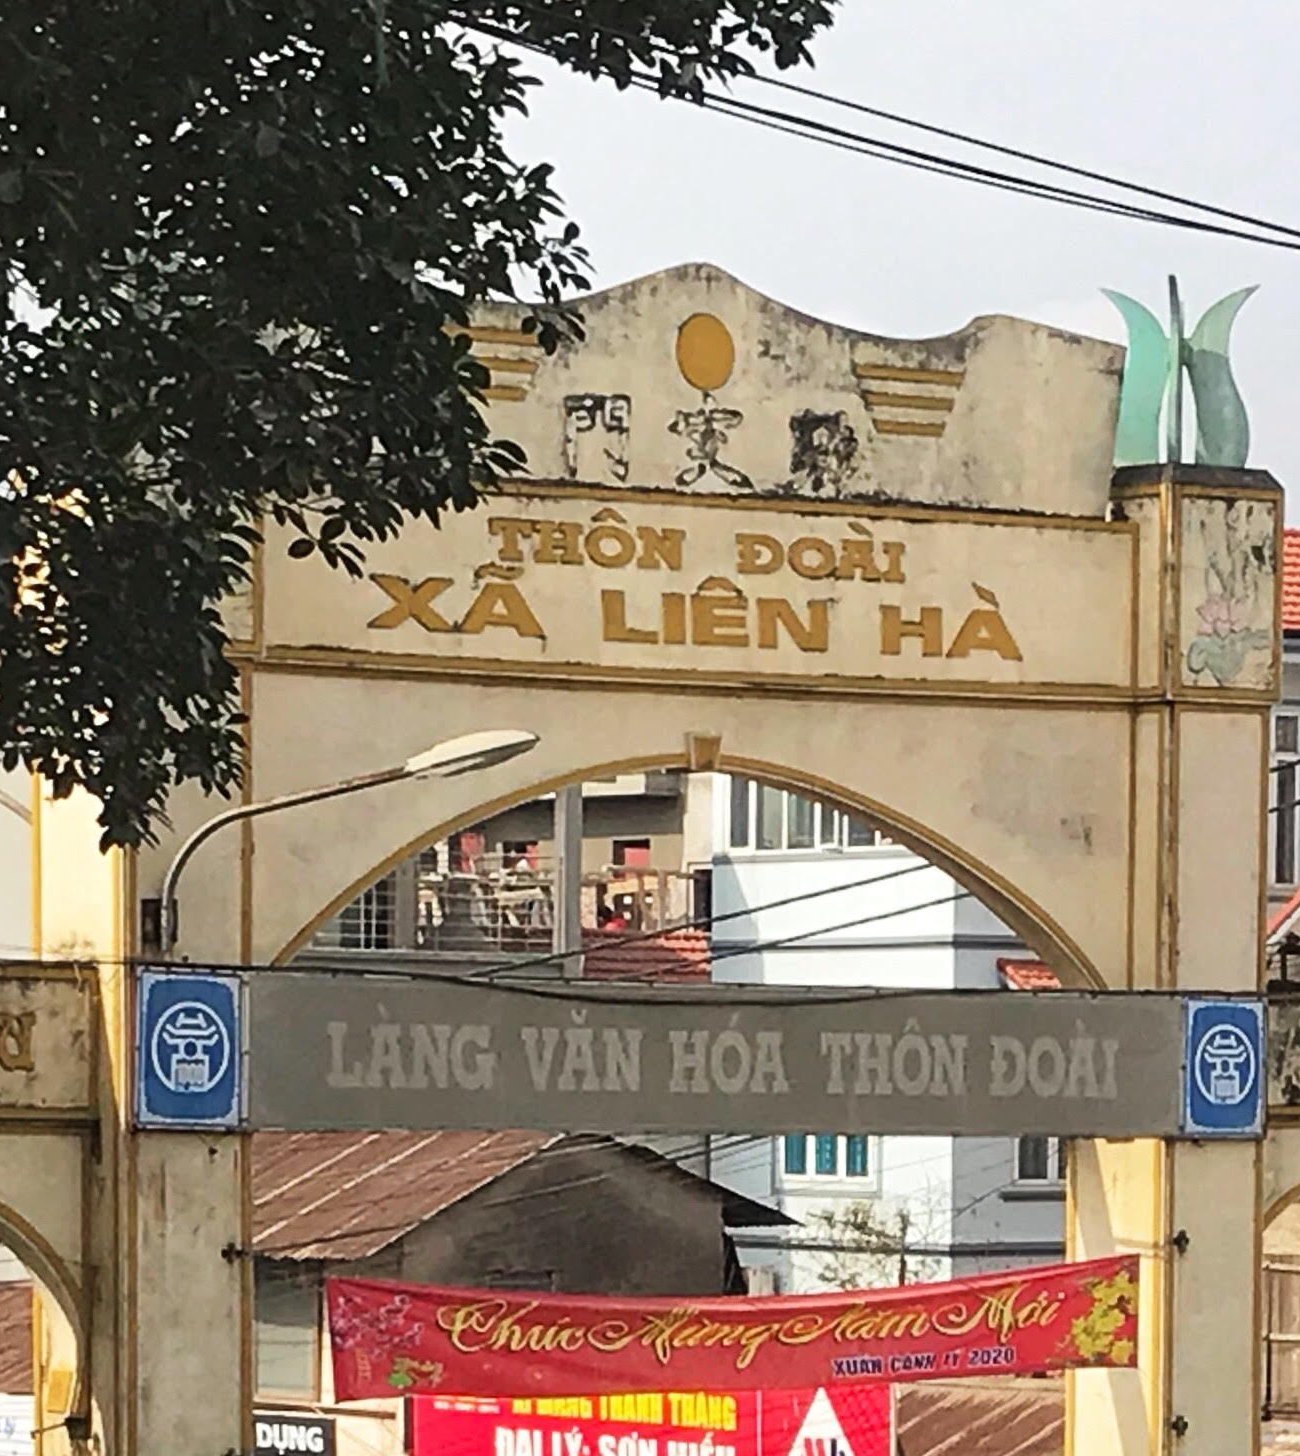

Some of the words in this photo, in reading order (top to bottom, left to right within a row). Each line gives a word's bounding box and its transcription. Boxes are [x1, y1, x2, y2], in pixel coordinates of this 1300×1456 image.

[487, 507, 687, 571] THÔN
[734, 521, 907, 584] ĐOÀI
[366, 561, 547, 641] XÃ
[601, 576, 831, 653] LIÊN
[879, 581, 1024, 661] HÀ
[325, 1005, 500, 1090] LÀNG
[521, 1009, 645, 1094] VĂN
[667, 1011, 791, 1096] HÓA
[819, 1016, 970, 1098] THÔN
[987, 1018, 1120, 1101] ĐOÀI
[437, 1300, 589, 1355] Chúc
[582, 1300, 779, 1369] Mừng
[779, 1299, 929, 1345] Năm
[928, 1282, 1066, 1345] Mới
[968, 1345, 1016, 1368] 2020
[255, 1421, 325, 1456] DỤNG
